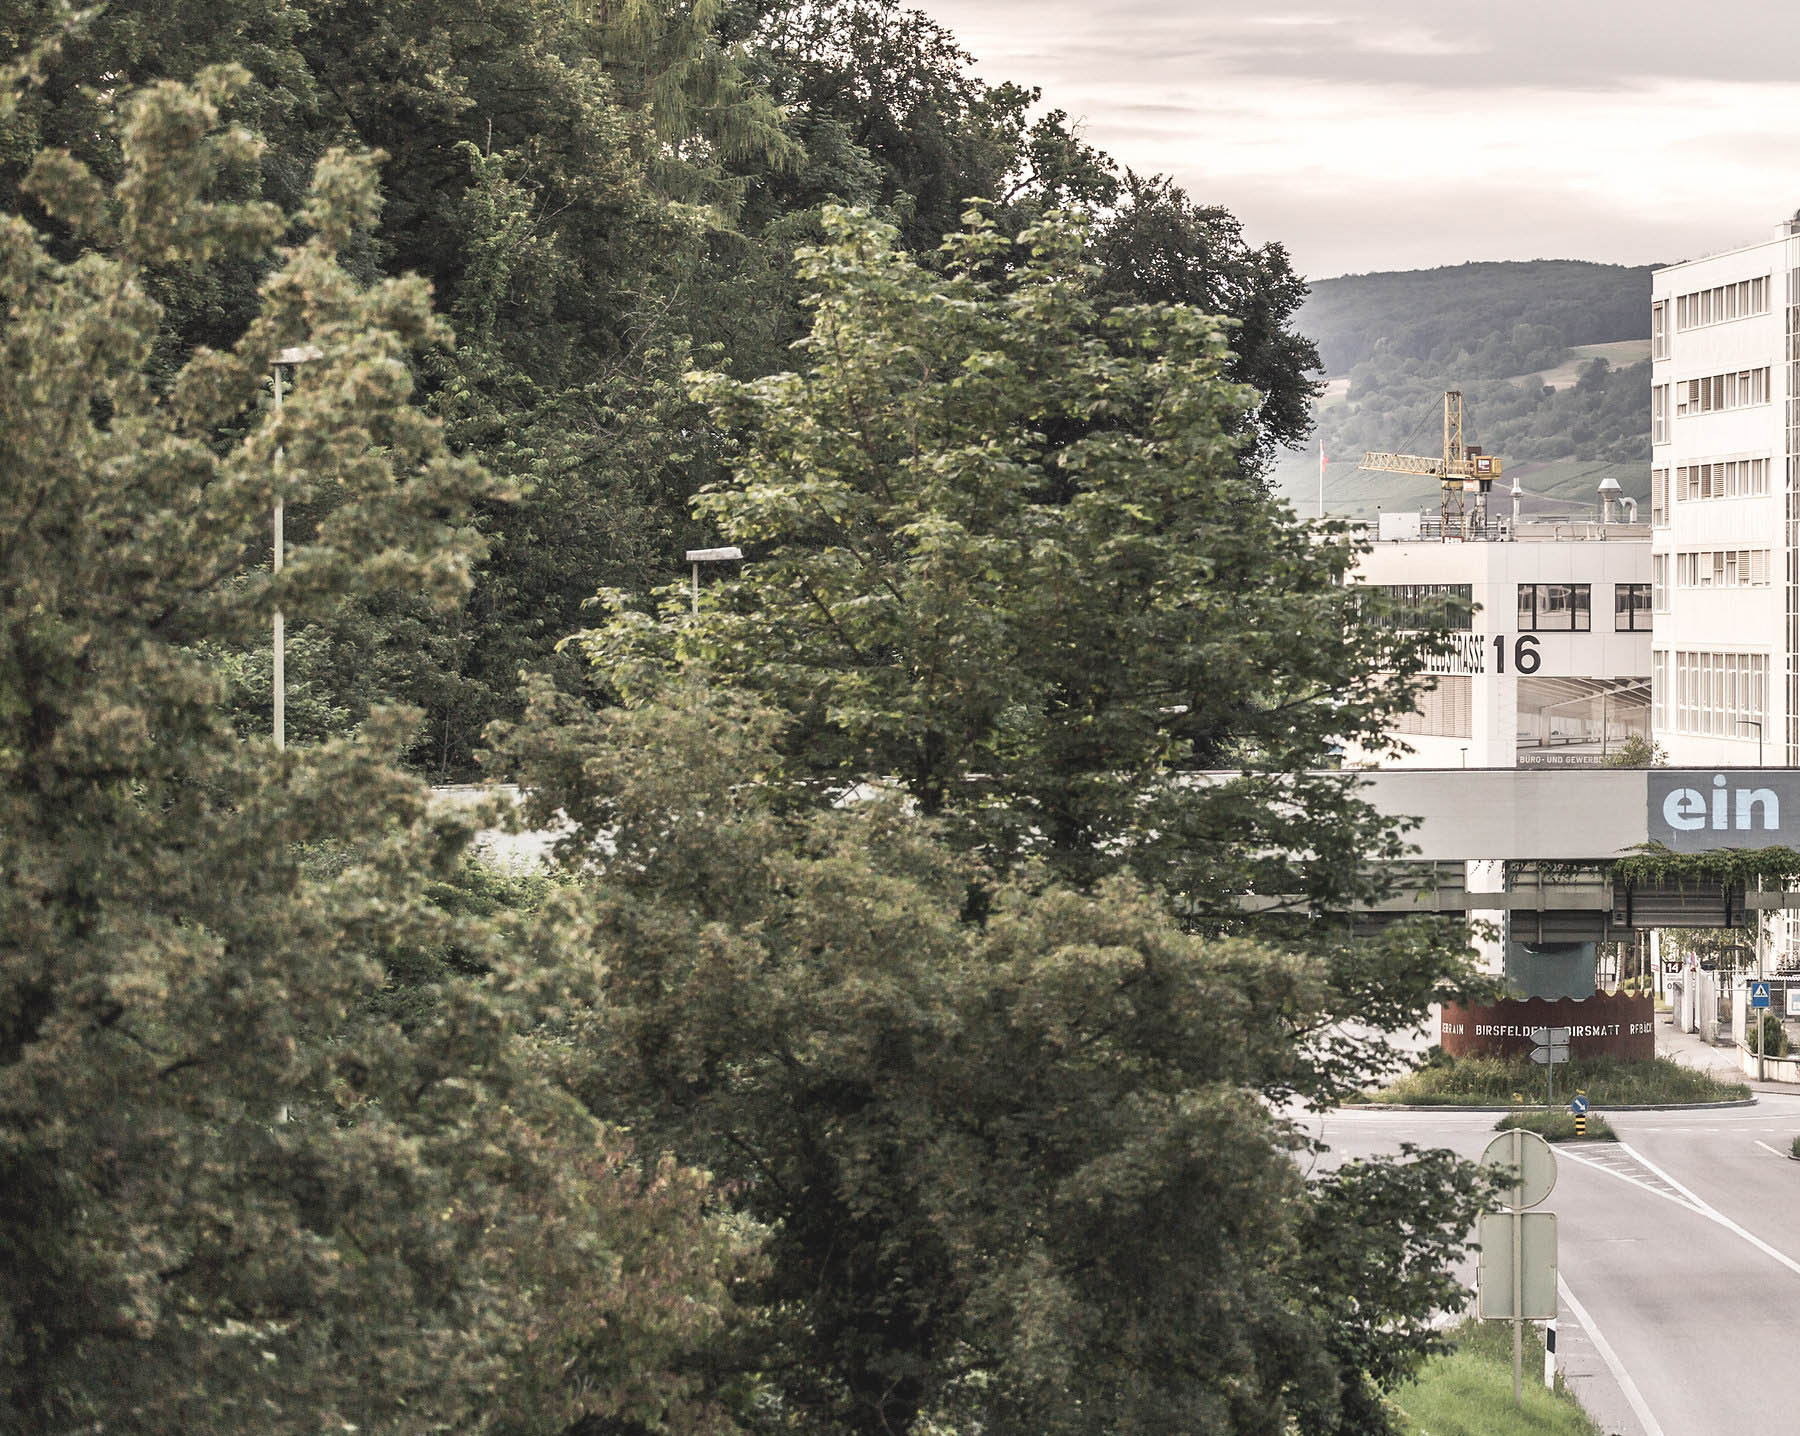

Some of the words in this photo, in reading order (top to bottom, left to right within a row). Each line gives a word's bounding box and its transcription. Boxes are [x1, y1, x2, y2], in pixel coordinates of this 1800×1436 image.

[1493, 634, 1542, 675] 16
[1547, 755, 1563, 764] UND
[1663, 774, 1780, 831] ein
[1667, 963, 1679, 973] 14
